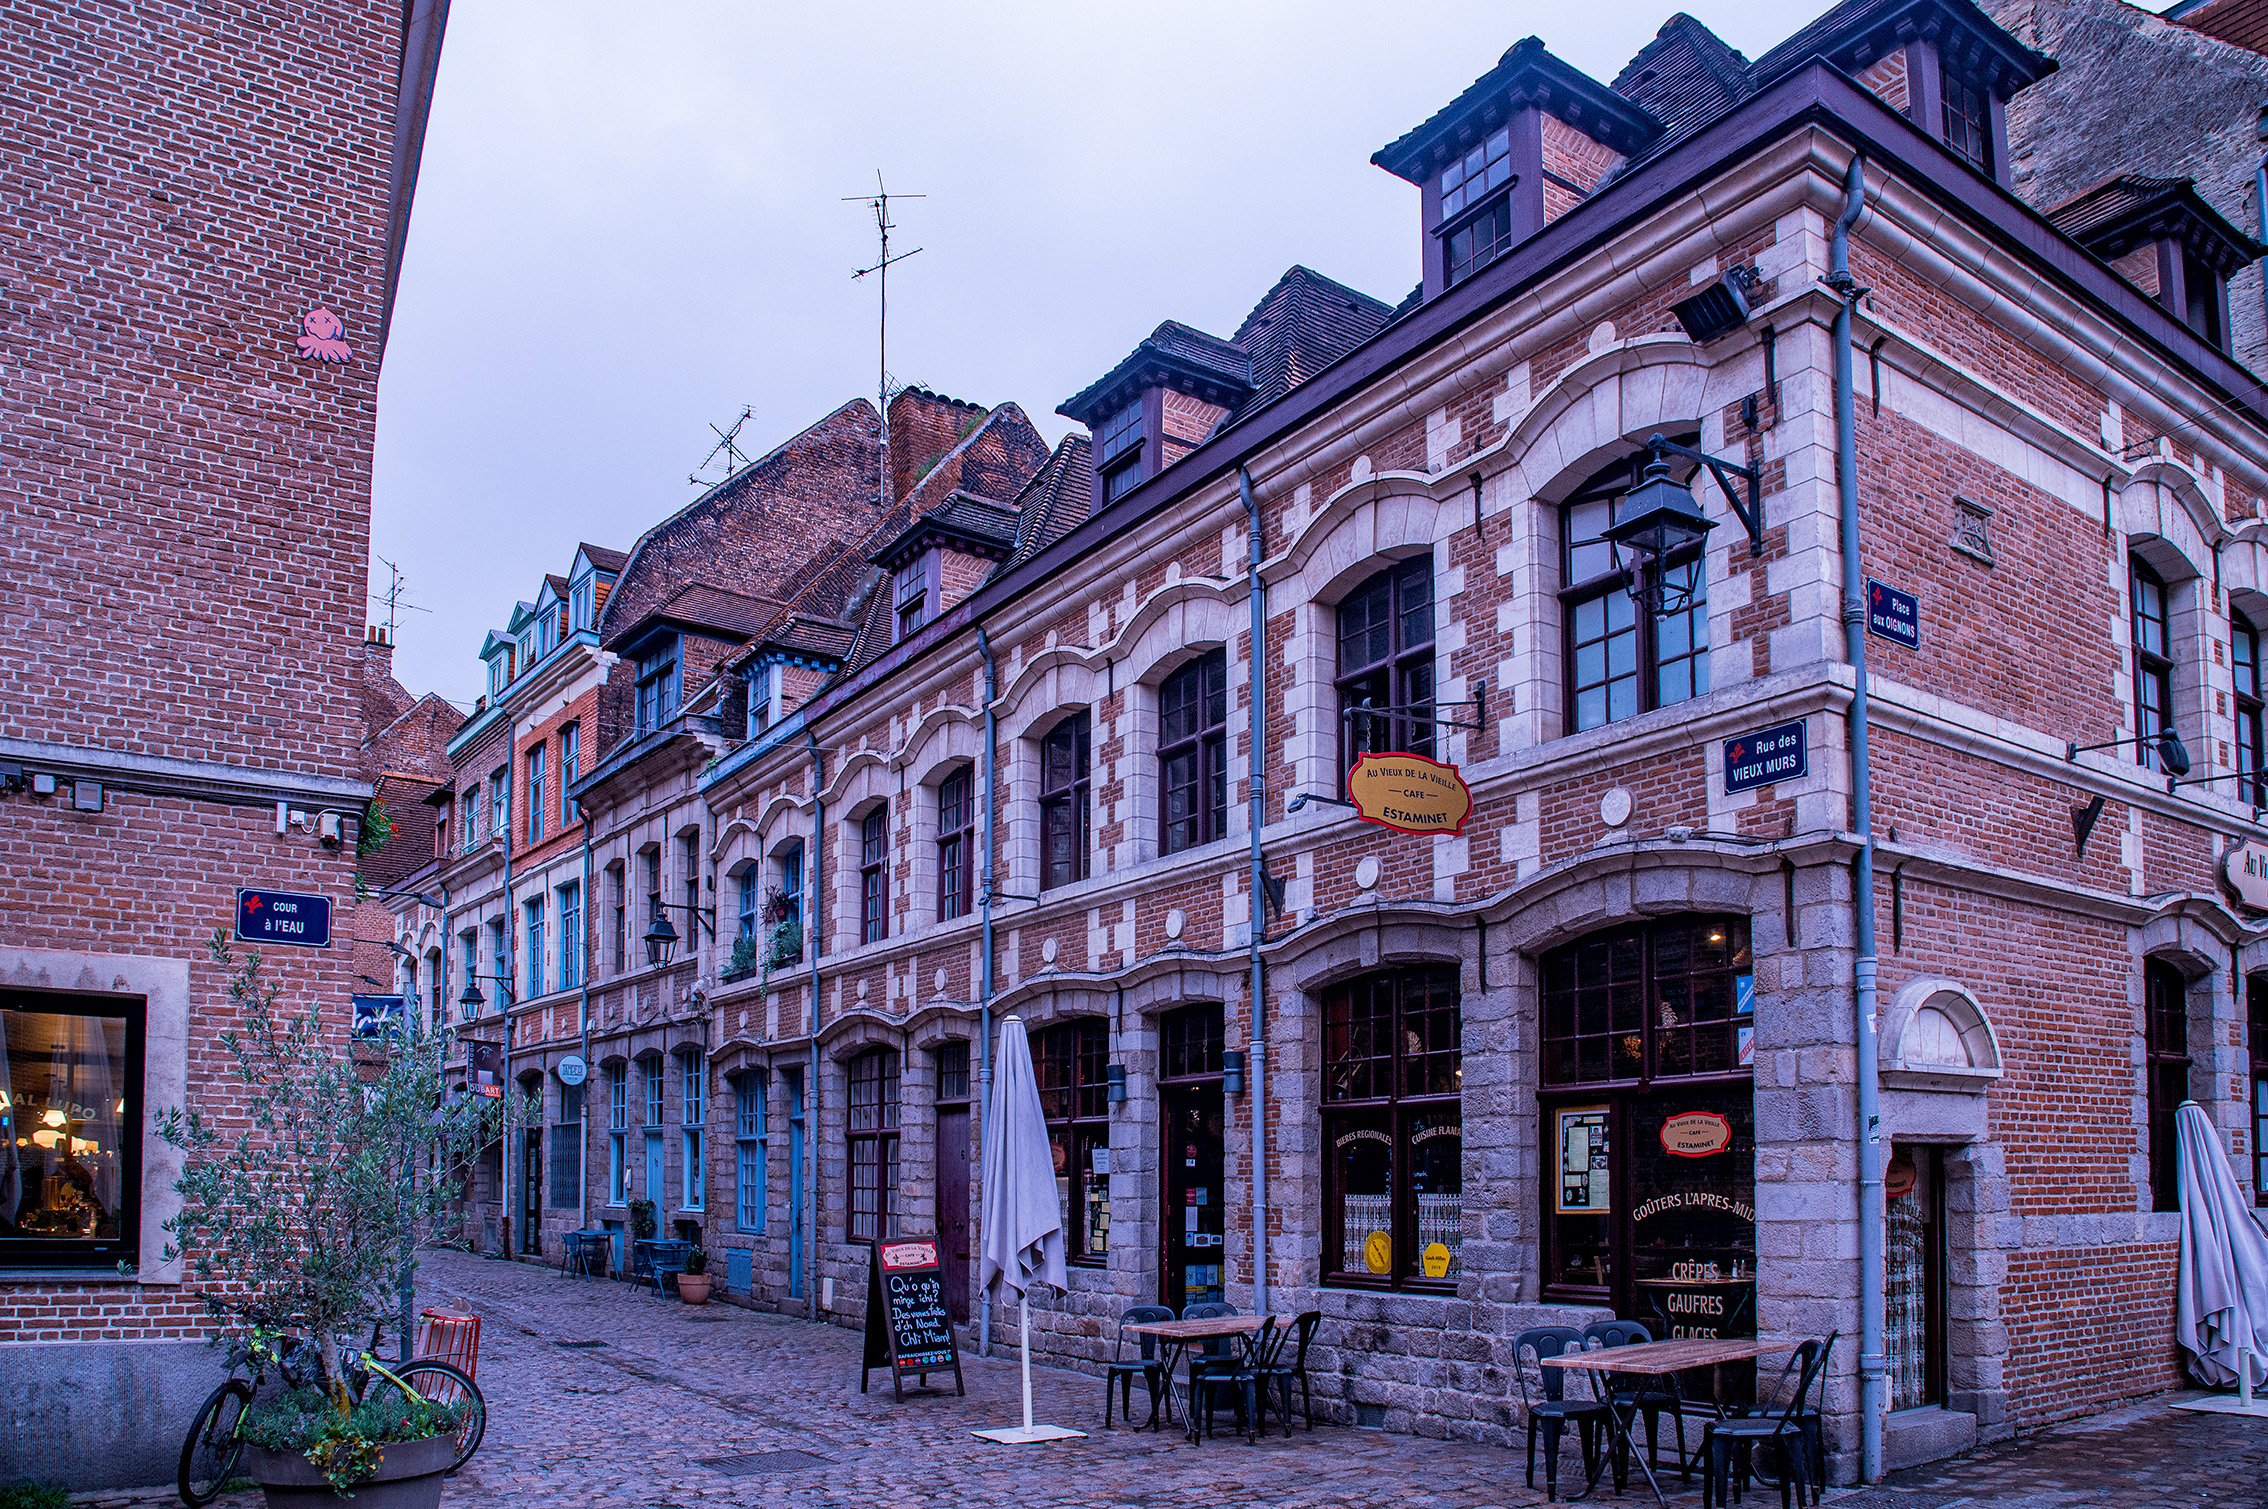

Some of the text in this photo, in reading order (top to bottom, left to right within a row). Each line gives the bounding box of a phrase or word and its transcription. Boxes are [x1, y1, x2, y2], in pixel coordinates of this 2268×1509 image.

[1892, 597, 1910, 616] Place
[1873, 613, 1915, 638] aux OIGNONS
[1756, 734, 1797, 755] Rue des
[1733, 754, 1796, 781] VIEUX MURS
[1367, 767, 1456, 792] AU VIEUX DE LA VIEILLE
[1403, 789, 1425, 799] CAFE
[1383, 806, 1447, 824] ESTAMINET
[272, 902, 298, 914] COUR
[264, 918, 304, 934] à l'EAU
[470, 1083, 500, 1095] DUBART
[1412, 1127, 1437, 1145] CUISINE
[1678, 1140, 1714, 1149] ESTAMINET
[1633, 1193, 1682, 1222] GOÛTERS
[1672, 1258, 1719, 1281] CRÊPES
[1667, 1293, 1724, 1316] GAUFRES
